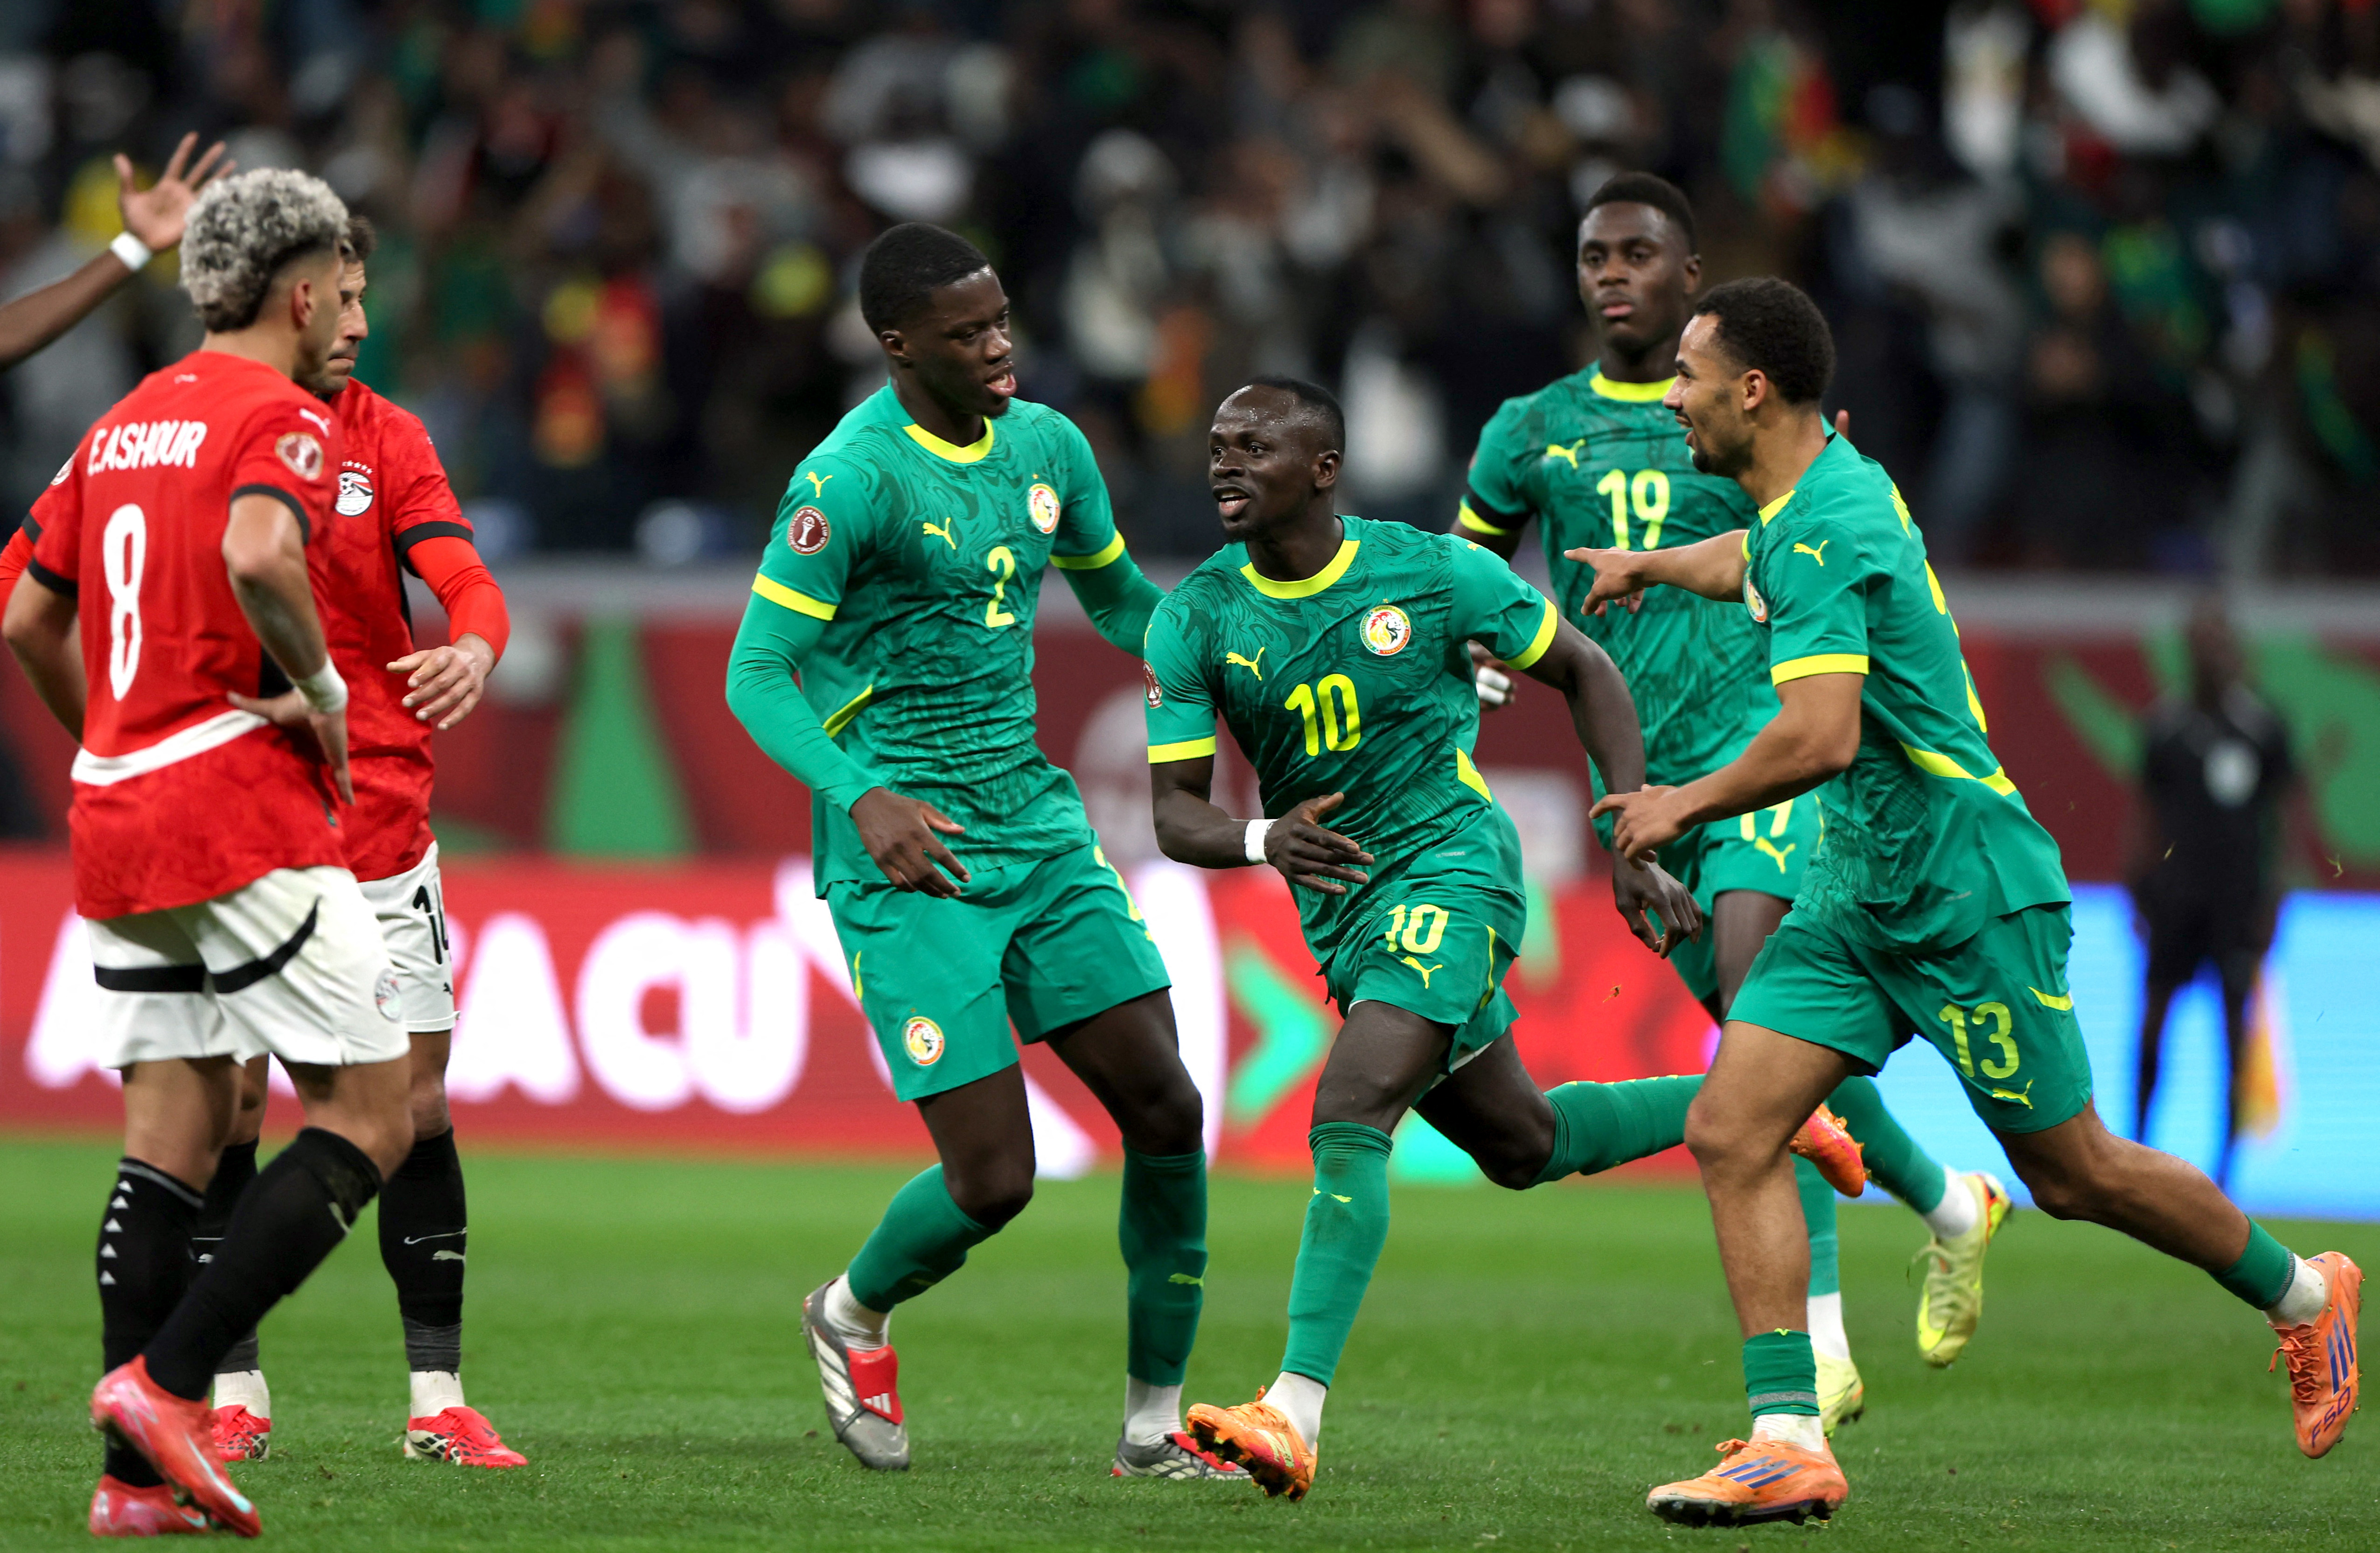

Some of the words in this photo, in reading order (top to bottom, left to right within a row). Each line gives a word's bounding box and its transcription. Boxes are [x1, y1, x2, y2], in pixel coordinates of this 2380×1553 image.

[1597, 469, 1670, 551] 19
[103, 503, 147, 701] 8
[985, 546, 1015, 628] 2
[1284, 673, 1361, 757] 10
[1385, 904, 1449, 954] 10
[1938, 1001, 2019, 1078] 13
